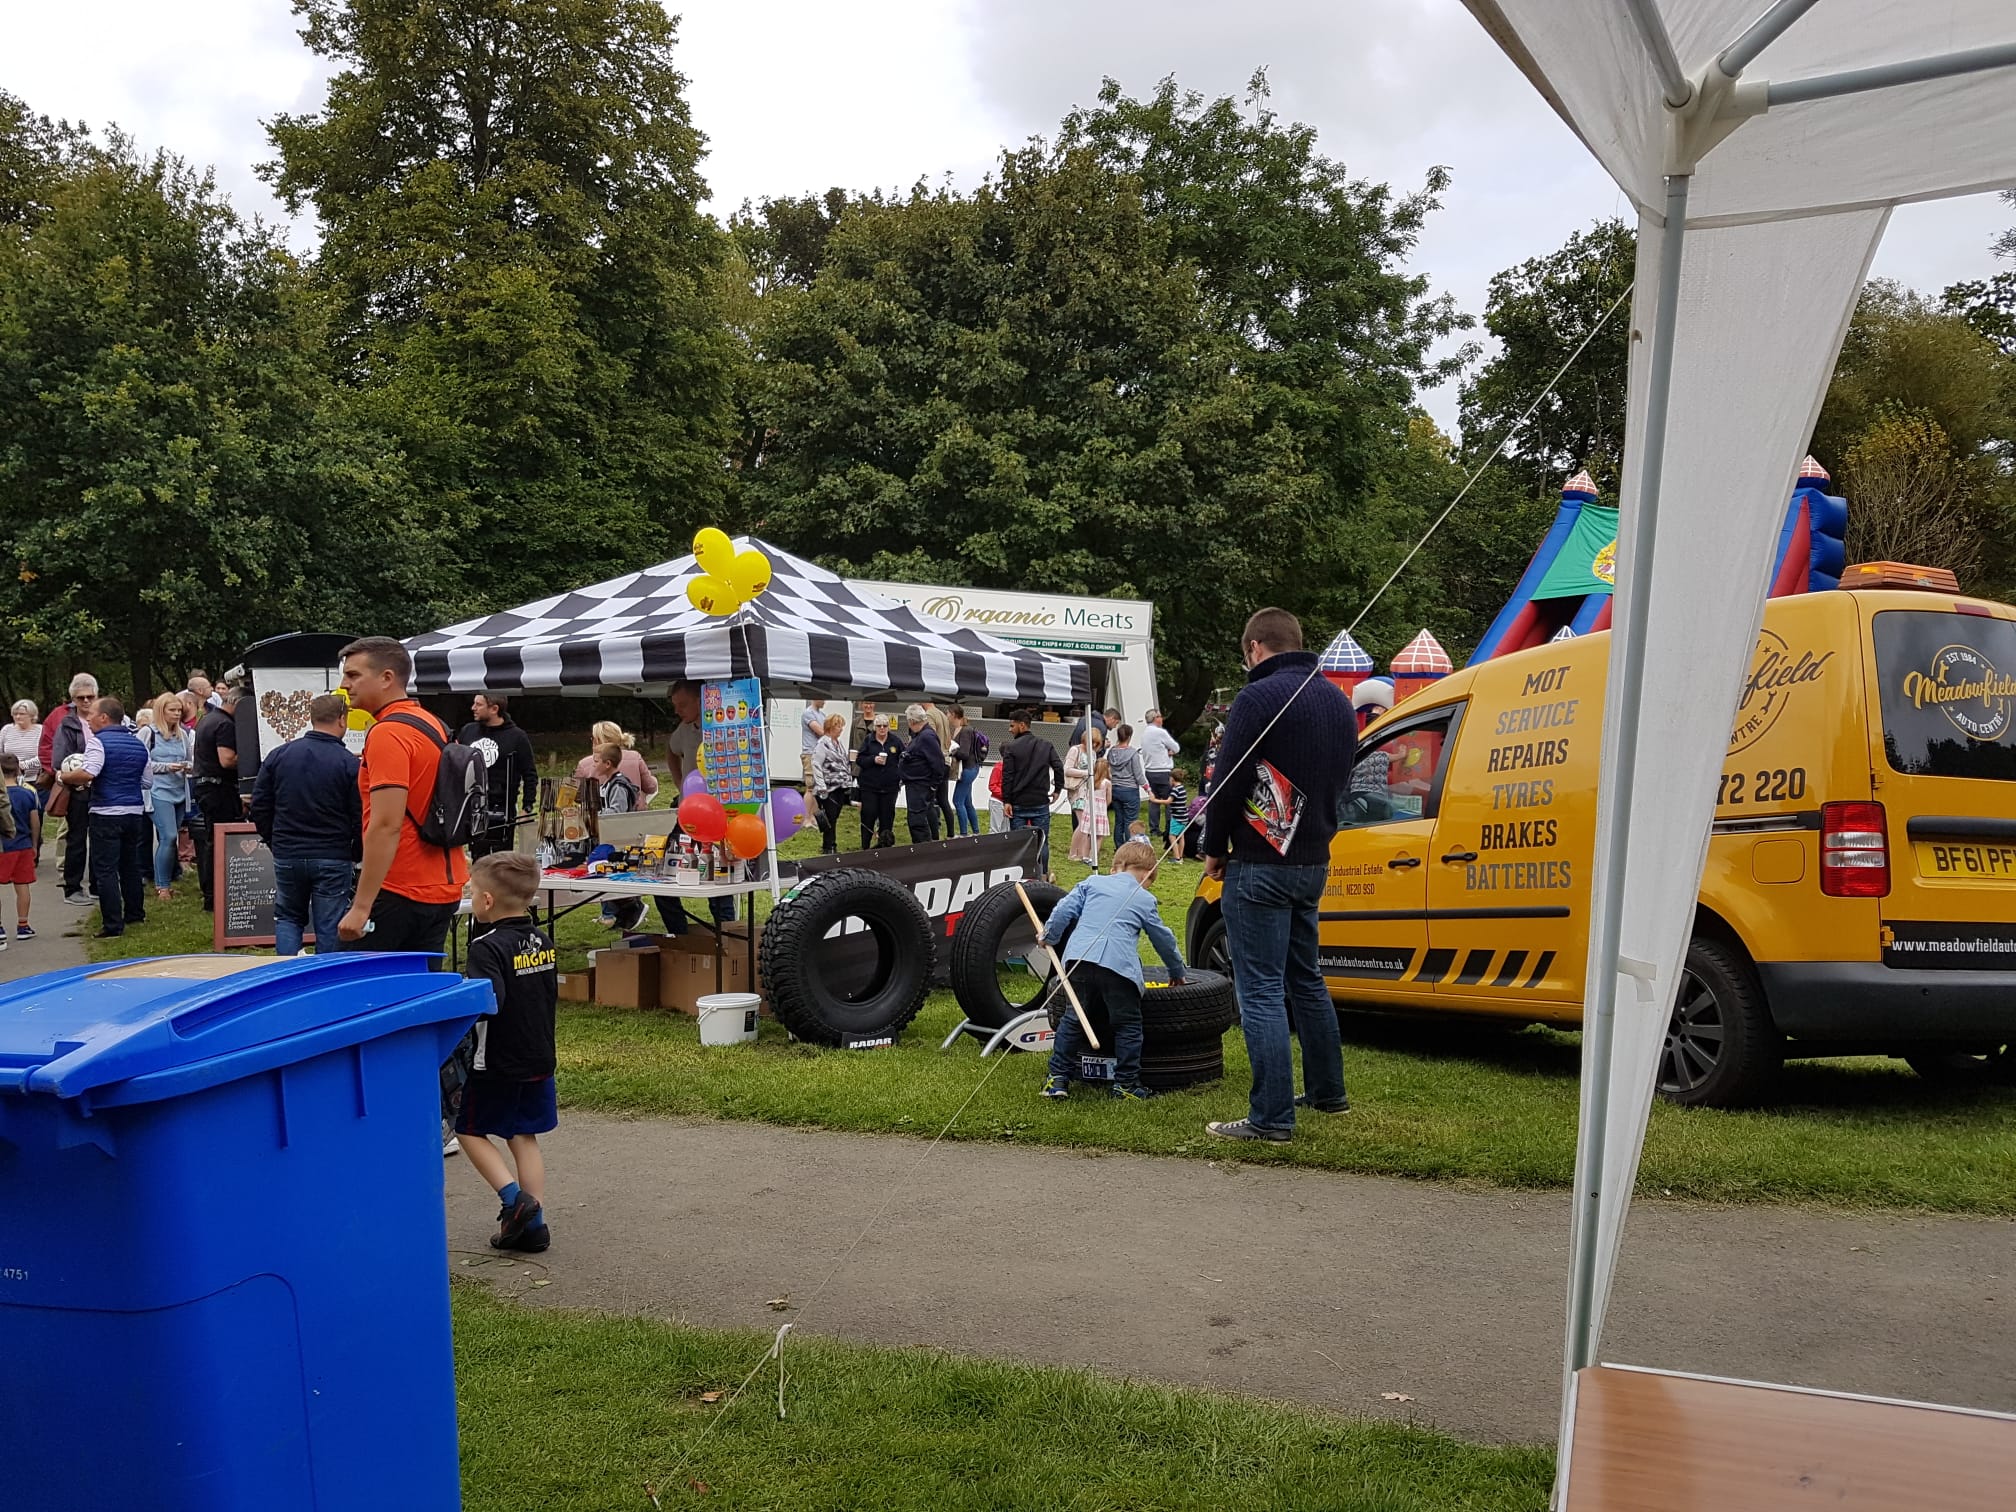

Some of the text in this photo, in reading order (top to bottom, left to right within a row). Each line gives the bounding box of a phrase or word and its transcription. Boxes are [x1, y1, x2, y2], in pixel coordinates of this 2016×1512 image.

[922, 596, 1134, 630] Organic Meats
[1041, 640, 1058, 648] CHIPS
[1946, 652, 1977, 665] EST 1984
[1521, 666, 1571, 697] MOT
[1739, 650, 1835, 710] field
[1495, 699, 1579, 736] SERVICE
[1731, 714, 1763, 745] NTRE
[1956, 712, 2004, 734] AUTO CENTRE
[1487, 738, 1569, 773] REPAIRS
[1492, 779, 1554, 811] TYRES
[1717, 767, 1805, 806] 72 220
[1480, 818, 1558, 851] BRAKES
[1333, 863, 1362, 877] Industrial
[1363, 863, 1384, 876] Estate
[1987, 848, 2016, 873] PF
[1466, 860, 1572, 890] BATTERIES
[1325, 880, 1345, 898] land,
[1346, 883, 1361, 896] NE20
[513, 949, 556, 970] MAGPIE
[1318, 955, 1404, 970] adowfieldautocentre.co.uk
[849, 1037, 893, 1049] RADAR
[3, 1267, 28, 1281] 4751
